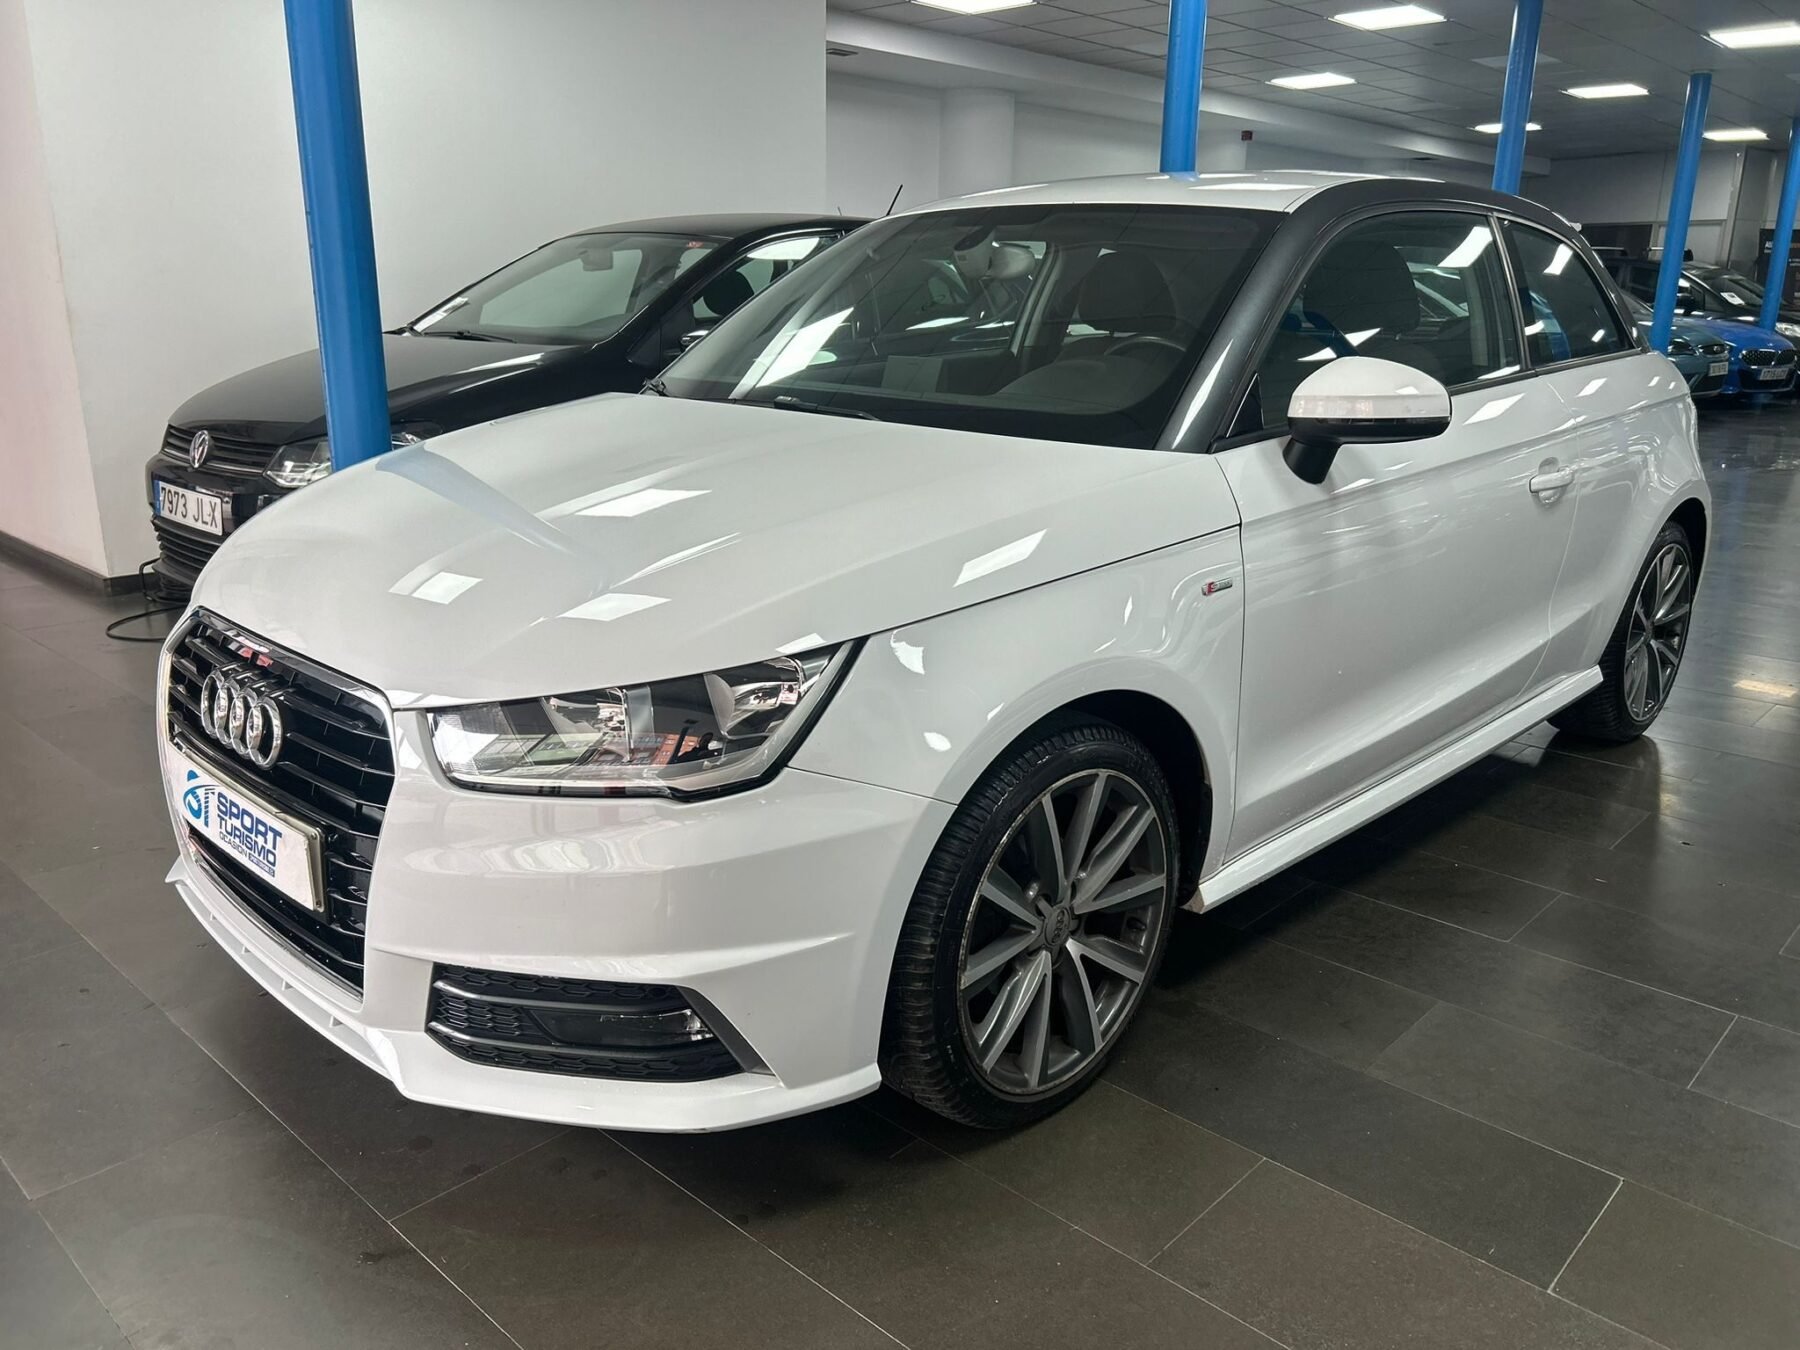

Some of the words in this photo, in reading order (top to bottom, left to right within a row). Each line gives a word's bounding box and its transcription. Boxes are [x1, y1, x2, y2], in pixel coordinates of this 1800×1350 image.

[161, 486, 188, 519] 7973
[193, 497, 217, 528] JLX
[217, 792, 282, 850] SPORT
[217, 814, 276, 867] TURISMO
